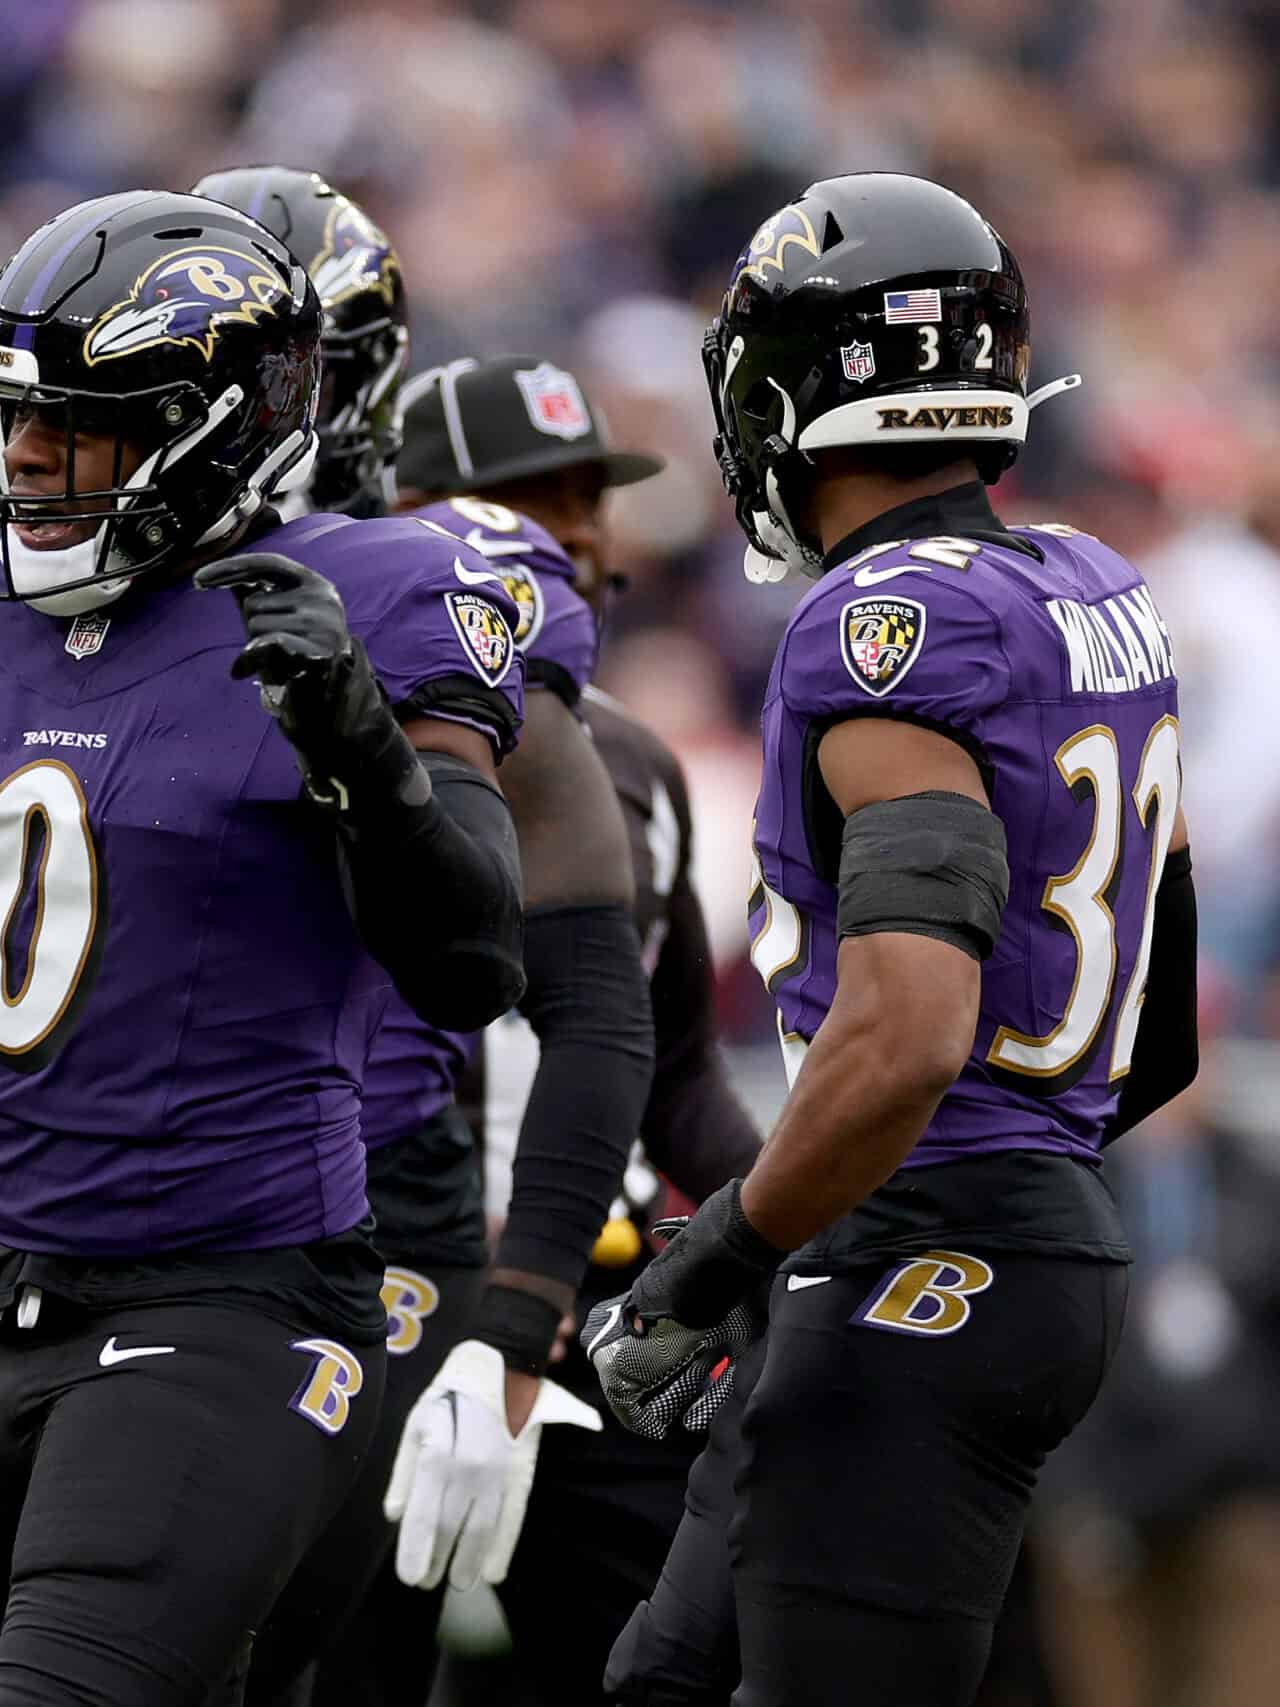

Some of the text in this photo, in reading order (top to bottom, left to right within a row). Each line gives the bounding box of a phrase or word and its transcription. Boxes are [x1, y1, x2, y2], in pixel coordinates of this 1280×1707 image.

[847, 359, 871, 377] NFL
[876, 406, 1014, 431] RAVENS
[851, 603, 915, 618] RAVENS
[71, 632, 98, 649] NFL
[855, 617, 884, 641] B
[23, 729, 107, 749] RAVENS
[985, 713, 1180, 1082] 32
[860, 1249, 994, 1336] B
[290, 1338, 363, 1434] B
